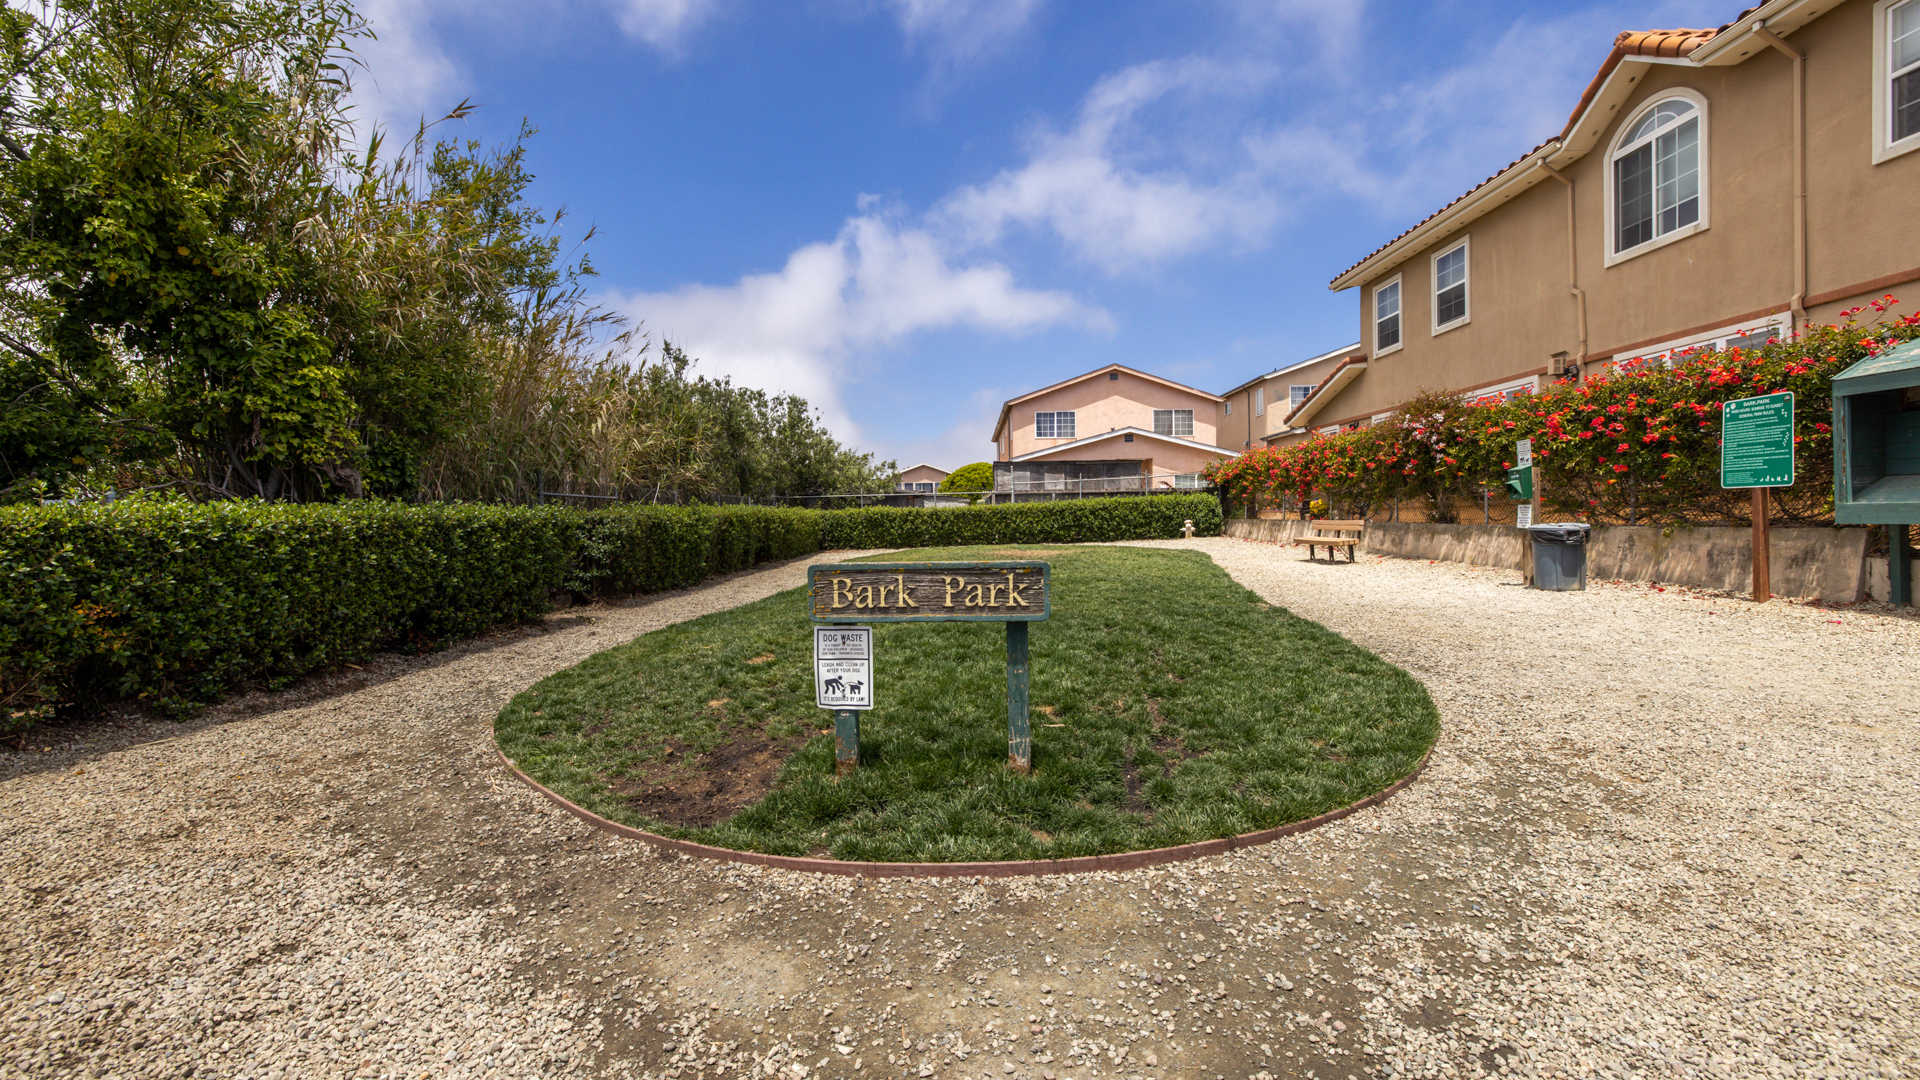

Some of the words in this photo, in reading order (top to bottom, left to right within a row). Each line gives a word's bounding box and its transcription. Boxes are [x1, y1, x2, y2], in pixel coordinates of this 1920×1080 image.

[831, 574, 919, 609] Bark
[941, 573, 1030, 608] Park
[823, 634, 838, 642] DOG
[840, 634, 863, 642] WASTE
